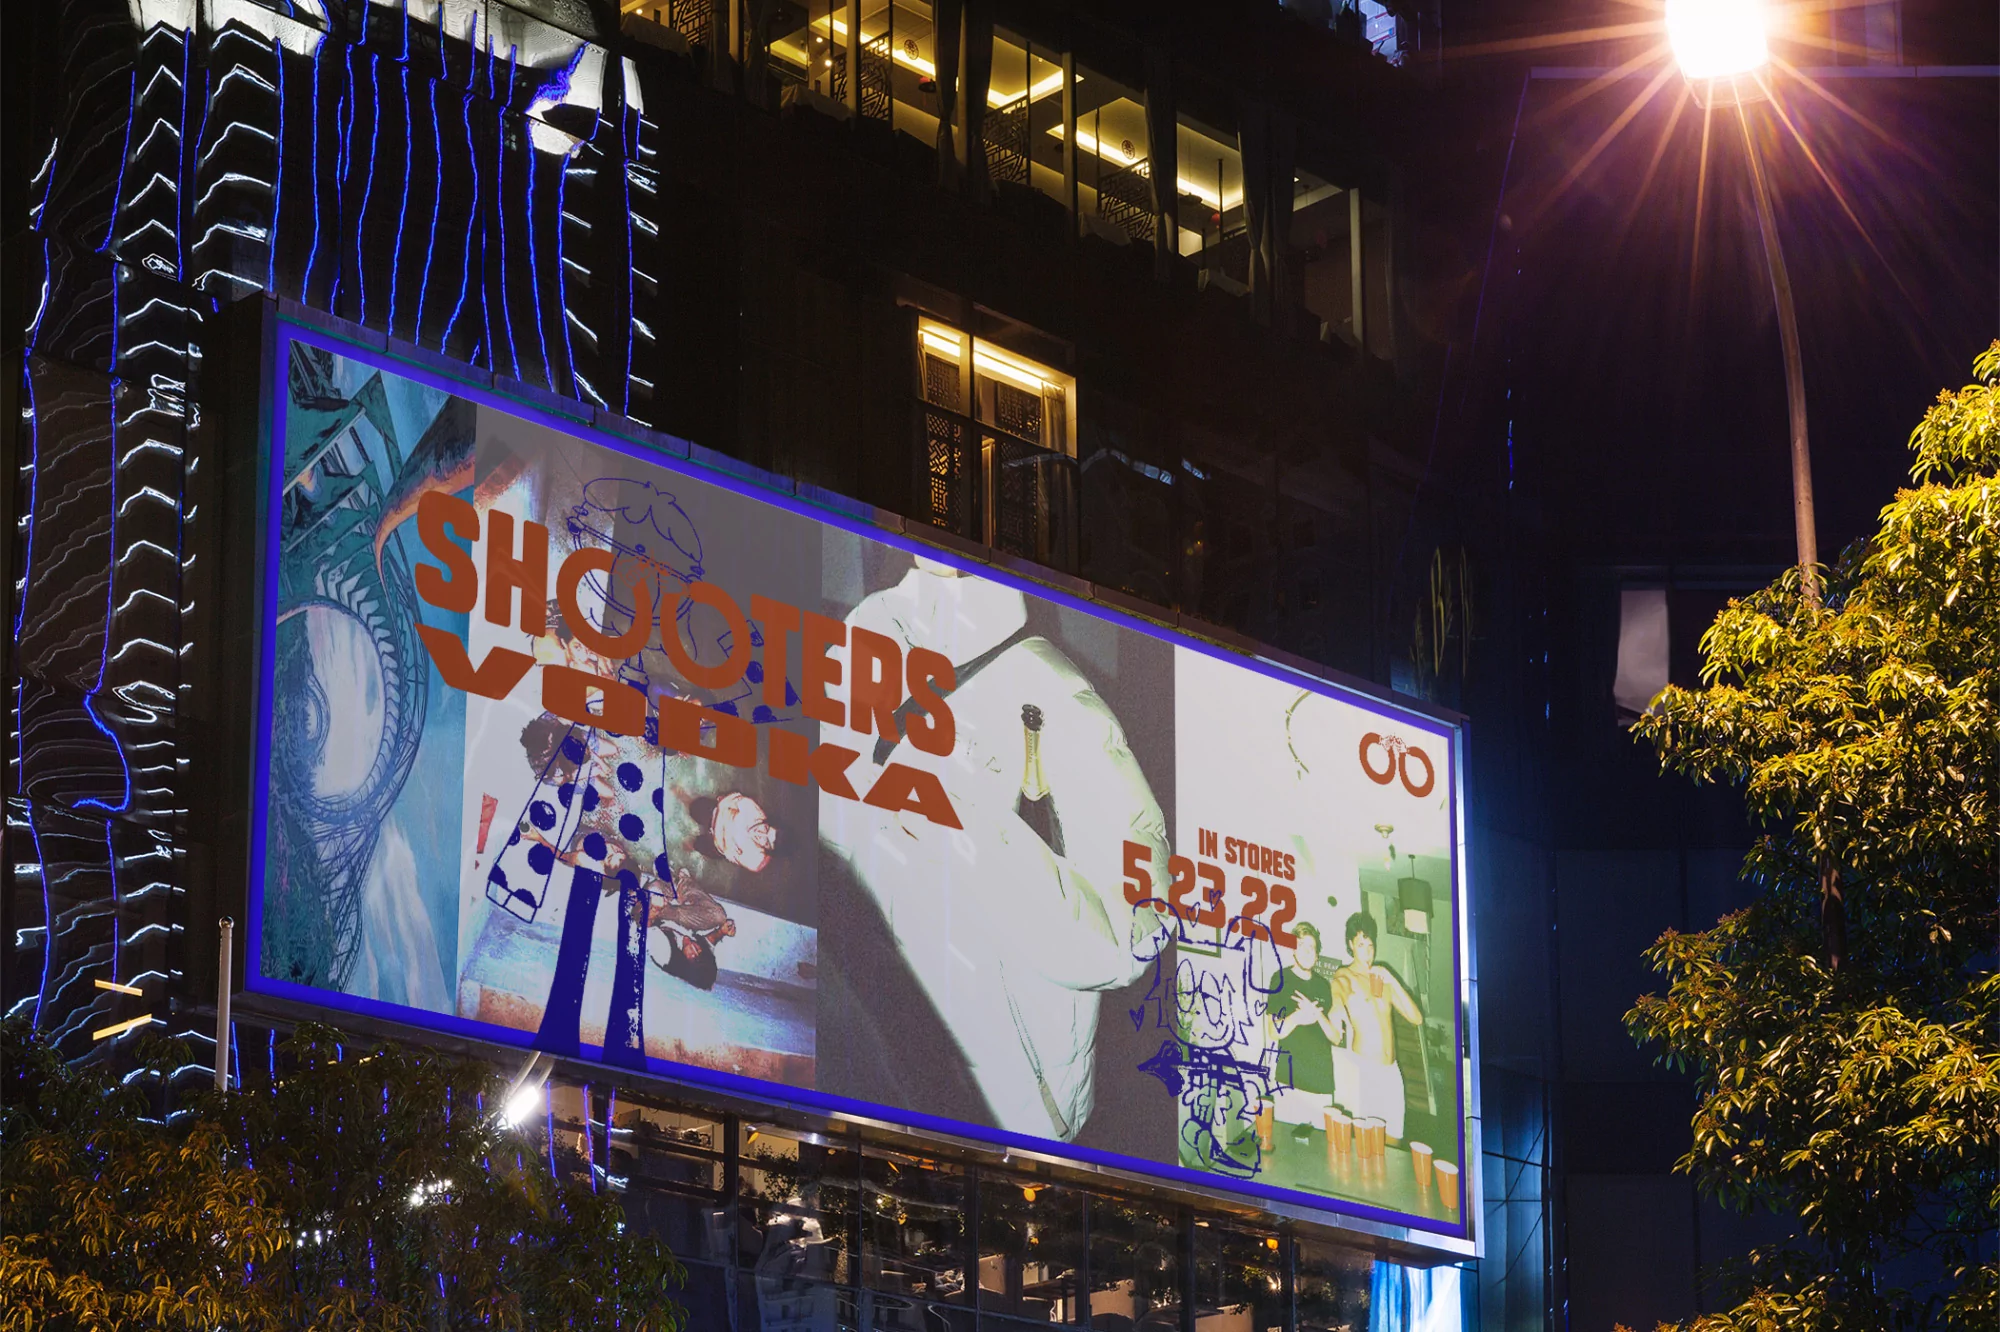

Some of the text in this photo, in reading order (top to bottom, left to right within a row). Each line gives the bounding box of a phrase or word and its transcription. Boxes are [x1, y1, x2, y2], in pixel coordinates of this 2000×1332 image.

[415, 490, 956, 757] SHOOTERS
[415, 622, 964, 831] VODKA
[1123, 840, 1297, 950] 5.23.22
[1198, 827, 1295, 881] IN STORES
